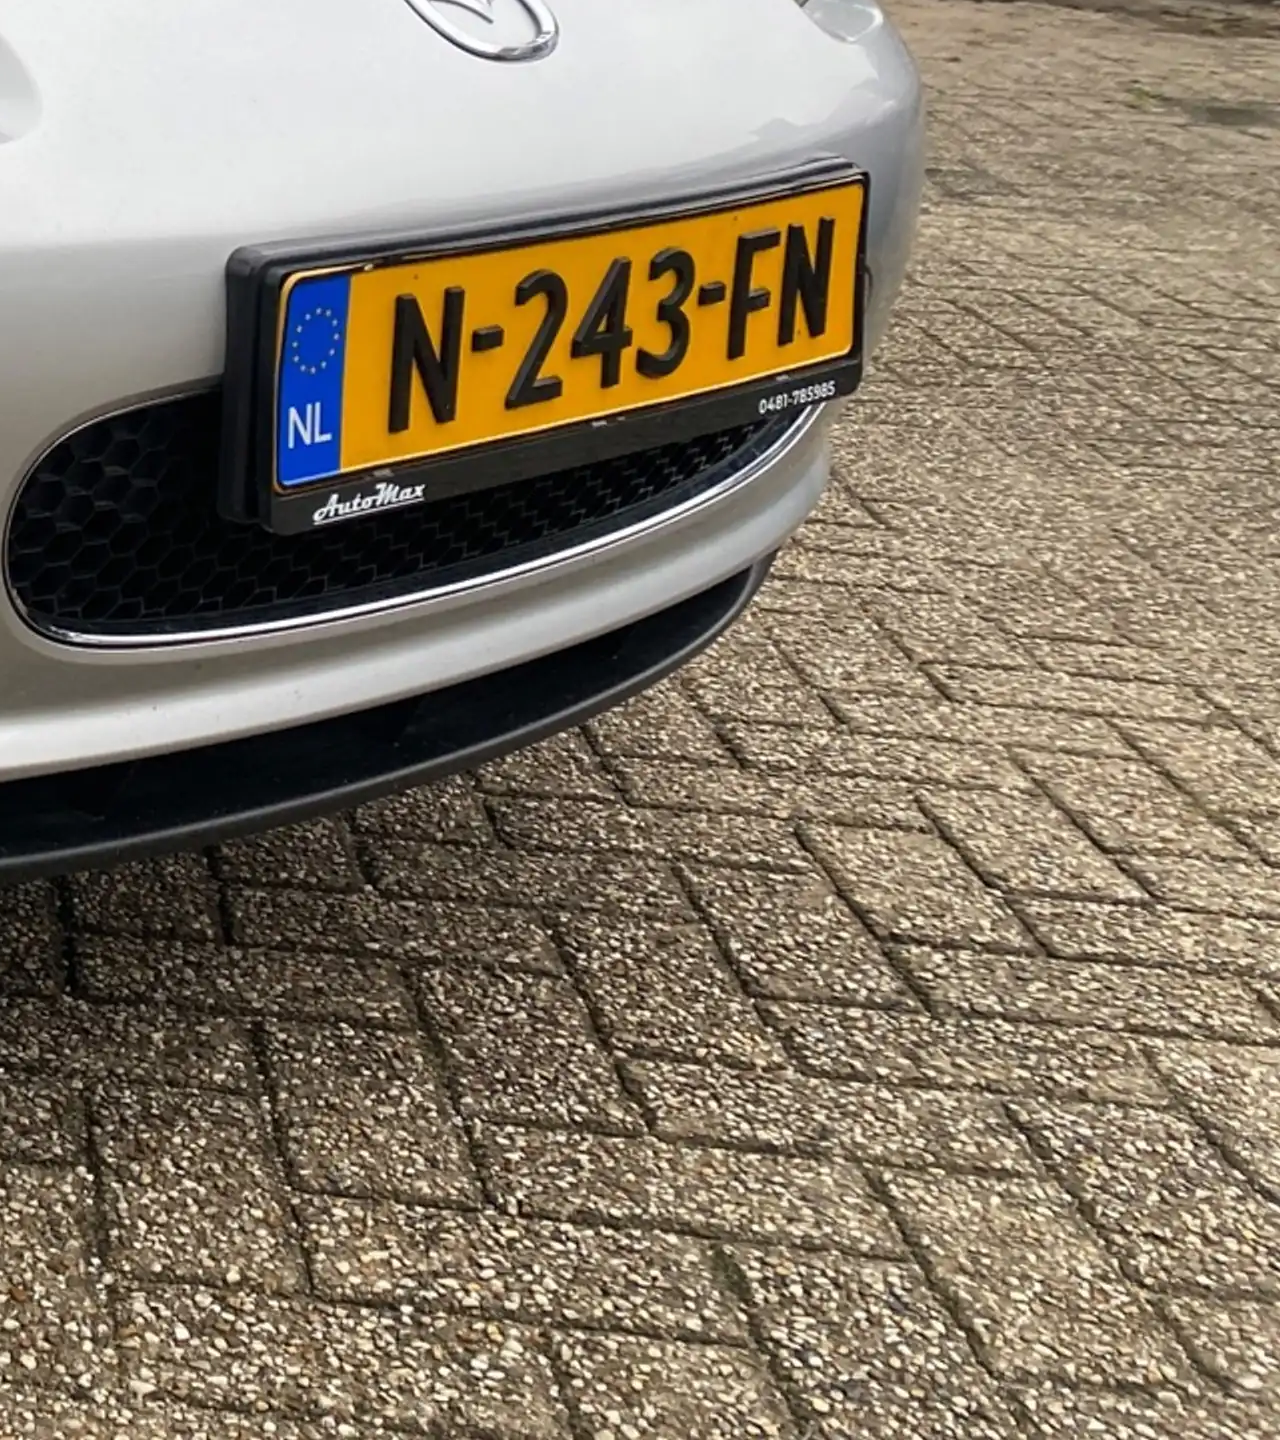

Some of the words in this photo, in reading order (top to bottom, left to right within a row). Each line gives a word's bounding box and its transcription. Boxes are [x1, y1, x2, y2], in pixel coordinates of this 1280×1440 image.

[388, 217, 835, 433] N-243-FN
[758, 380, 836, 414] 0481-785985
[288, 404, 332, 449] NL
